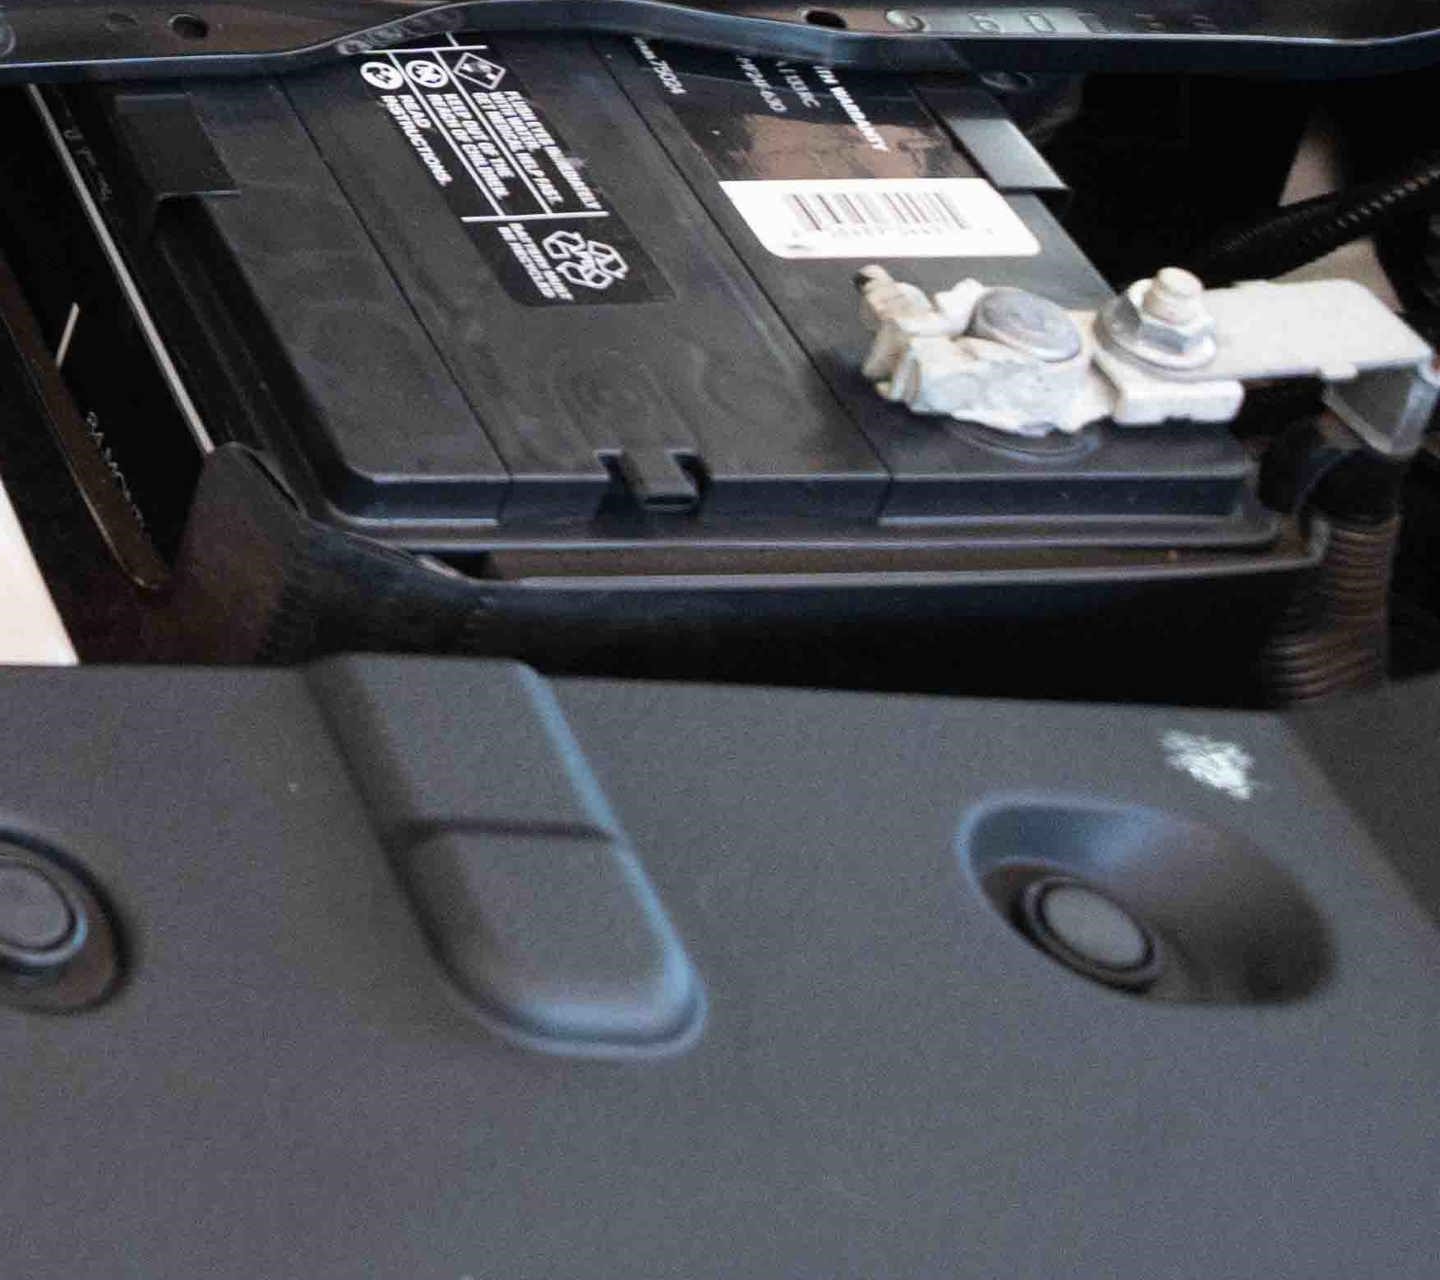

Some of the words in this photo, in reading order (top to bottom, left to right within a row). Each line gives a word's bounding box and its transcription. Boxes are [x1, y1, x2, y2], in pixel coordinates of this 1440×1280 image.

[397, 94, 432, 128] READ
[425, 93, 464, 127] REACH
[450, 128, 473, 143] OF
[441, 93, 473, 119] KEEP
[487, 91, 519, 116] WITH
[461, 120, 490, 141] OUT
[471, 92, 497, 110] GET
[484, 111, 526, 152] MEDICAL
[514, 152, 545, 177] HELP
[830, 86, 891, 153] WARRANTY
[477, 142, 500, 156] OF
[488, 157, 515, 178] THE
[508, 242, 556, 298] RECYCLED
